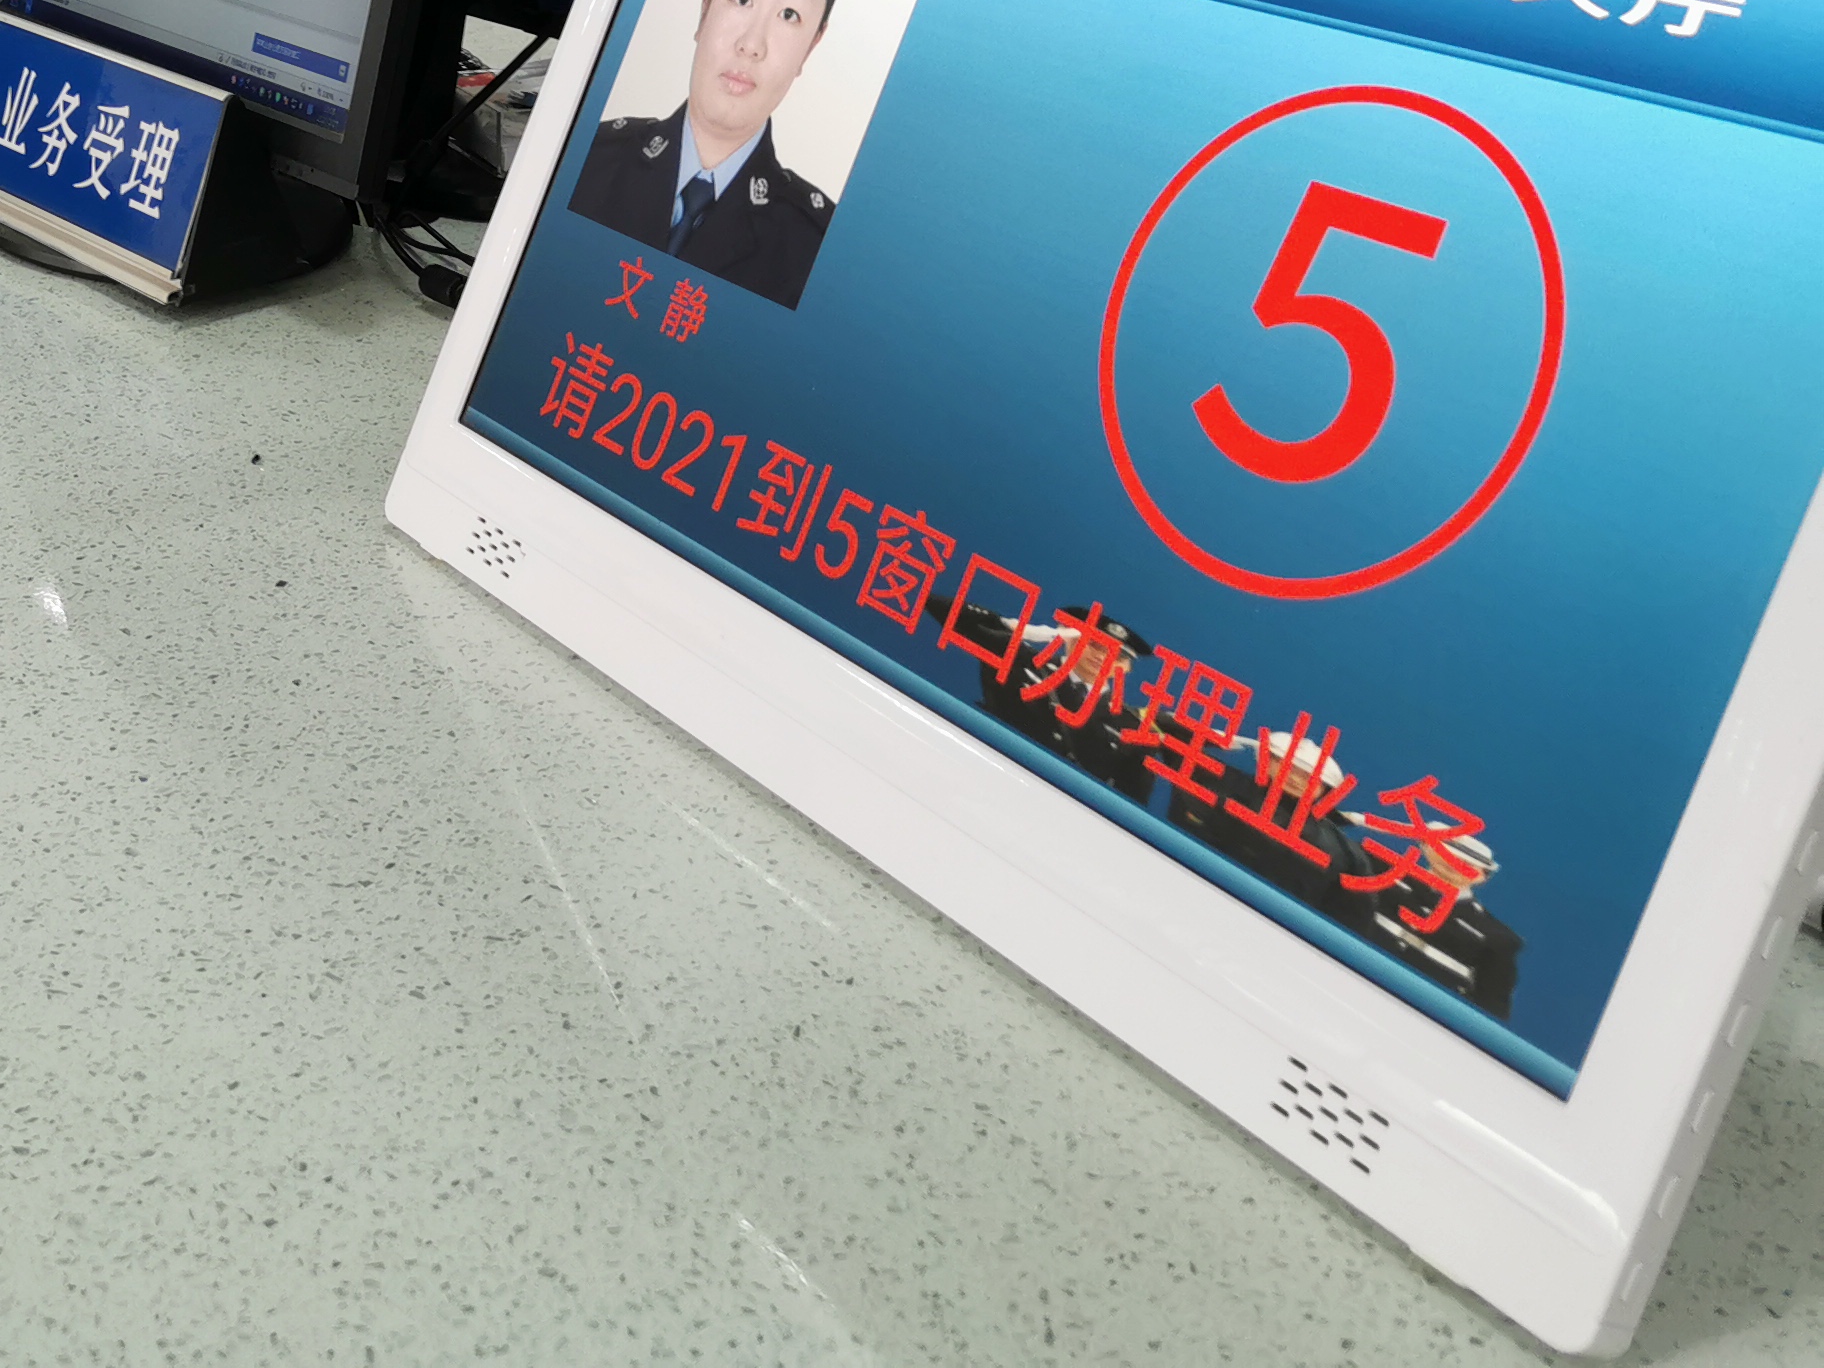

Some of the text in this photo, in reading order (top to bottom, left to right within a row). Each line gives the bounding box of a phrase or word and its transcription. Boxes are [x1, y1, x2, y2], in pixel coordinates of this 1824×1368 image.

[1193, 181, 1447, 484] 5
[538, 330, 1485, 933] 请2021到5窗口办理业务
